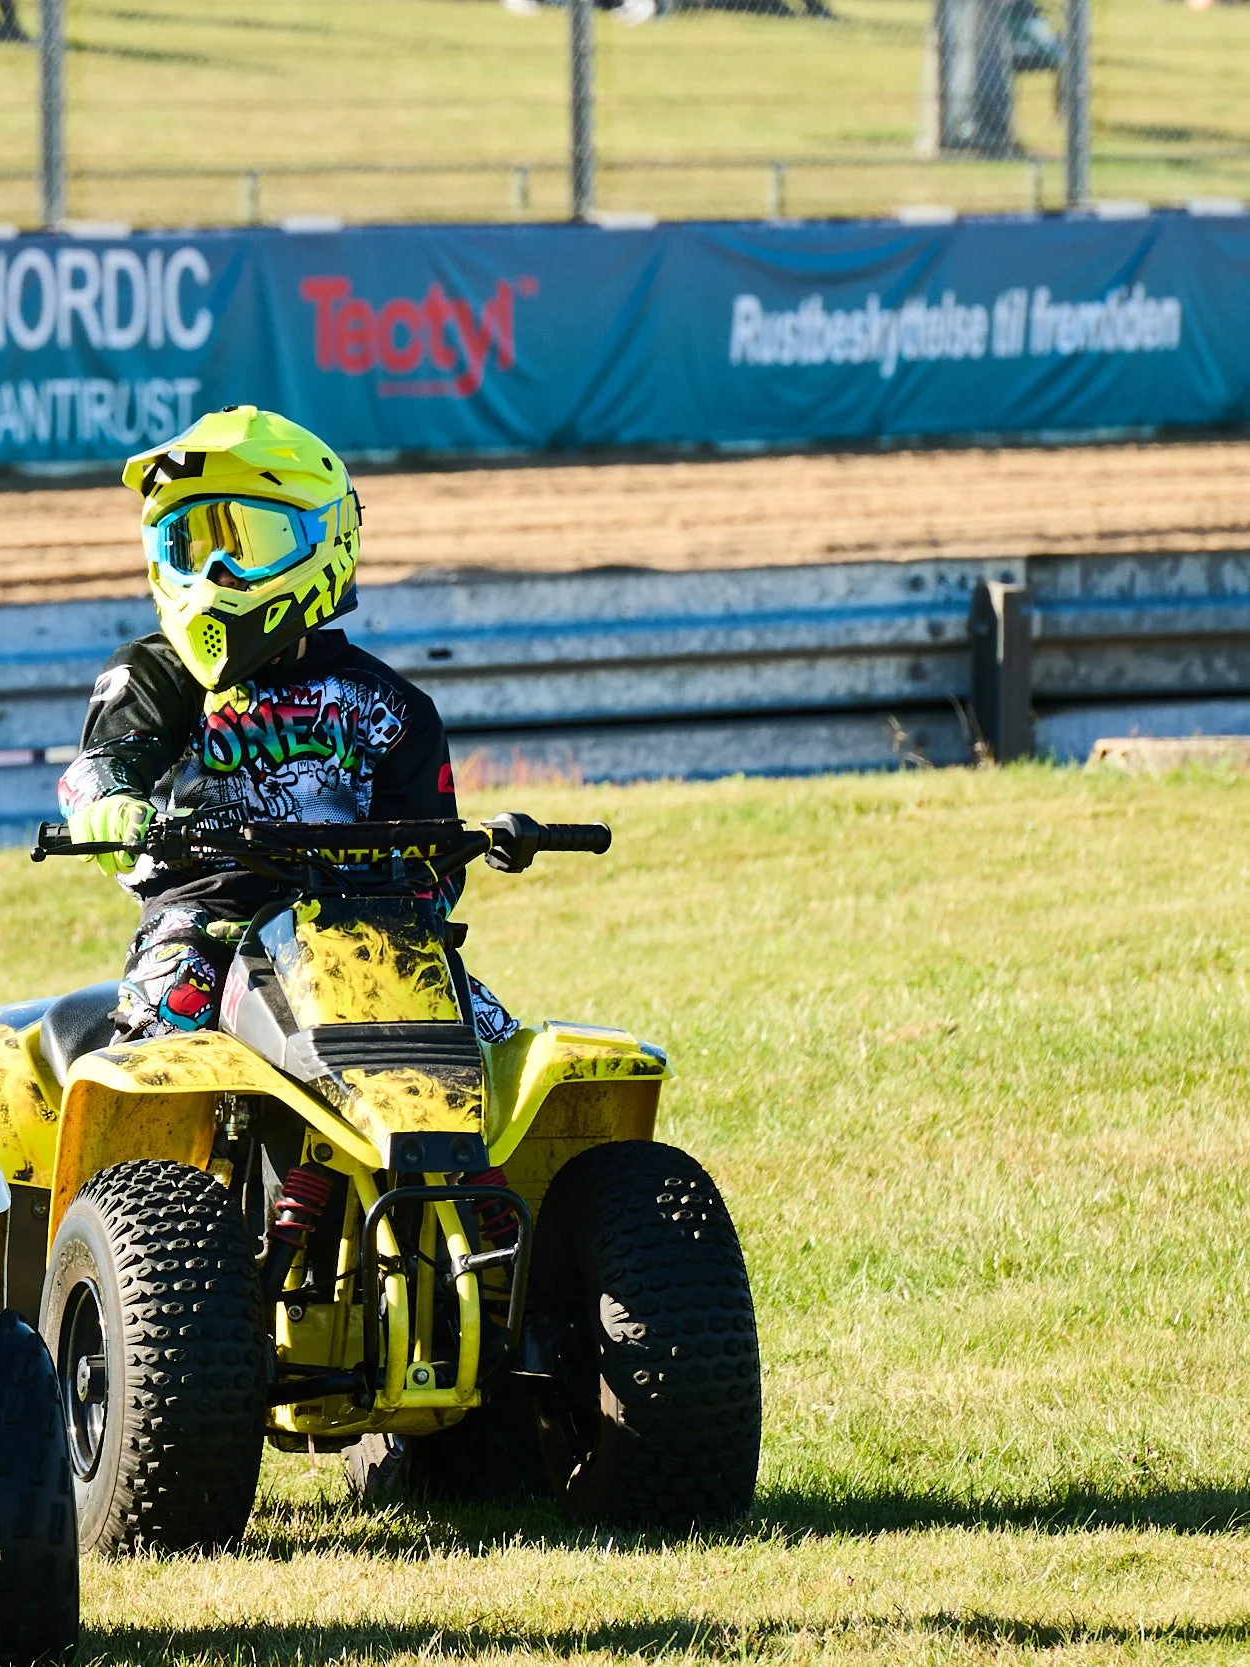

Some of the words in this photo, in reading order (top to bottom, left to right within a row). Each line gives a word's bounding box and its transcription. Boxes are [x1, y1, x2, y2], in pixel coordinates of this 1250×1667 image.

[299, 276, 515, 396] Tectyl
[730, 292, 990, 378] Rustbeskyttelse
[993, 288, 1028, 357] til
[1030, 283, 1181, 355] fremtiden
